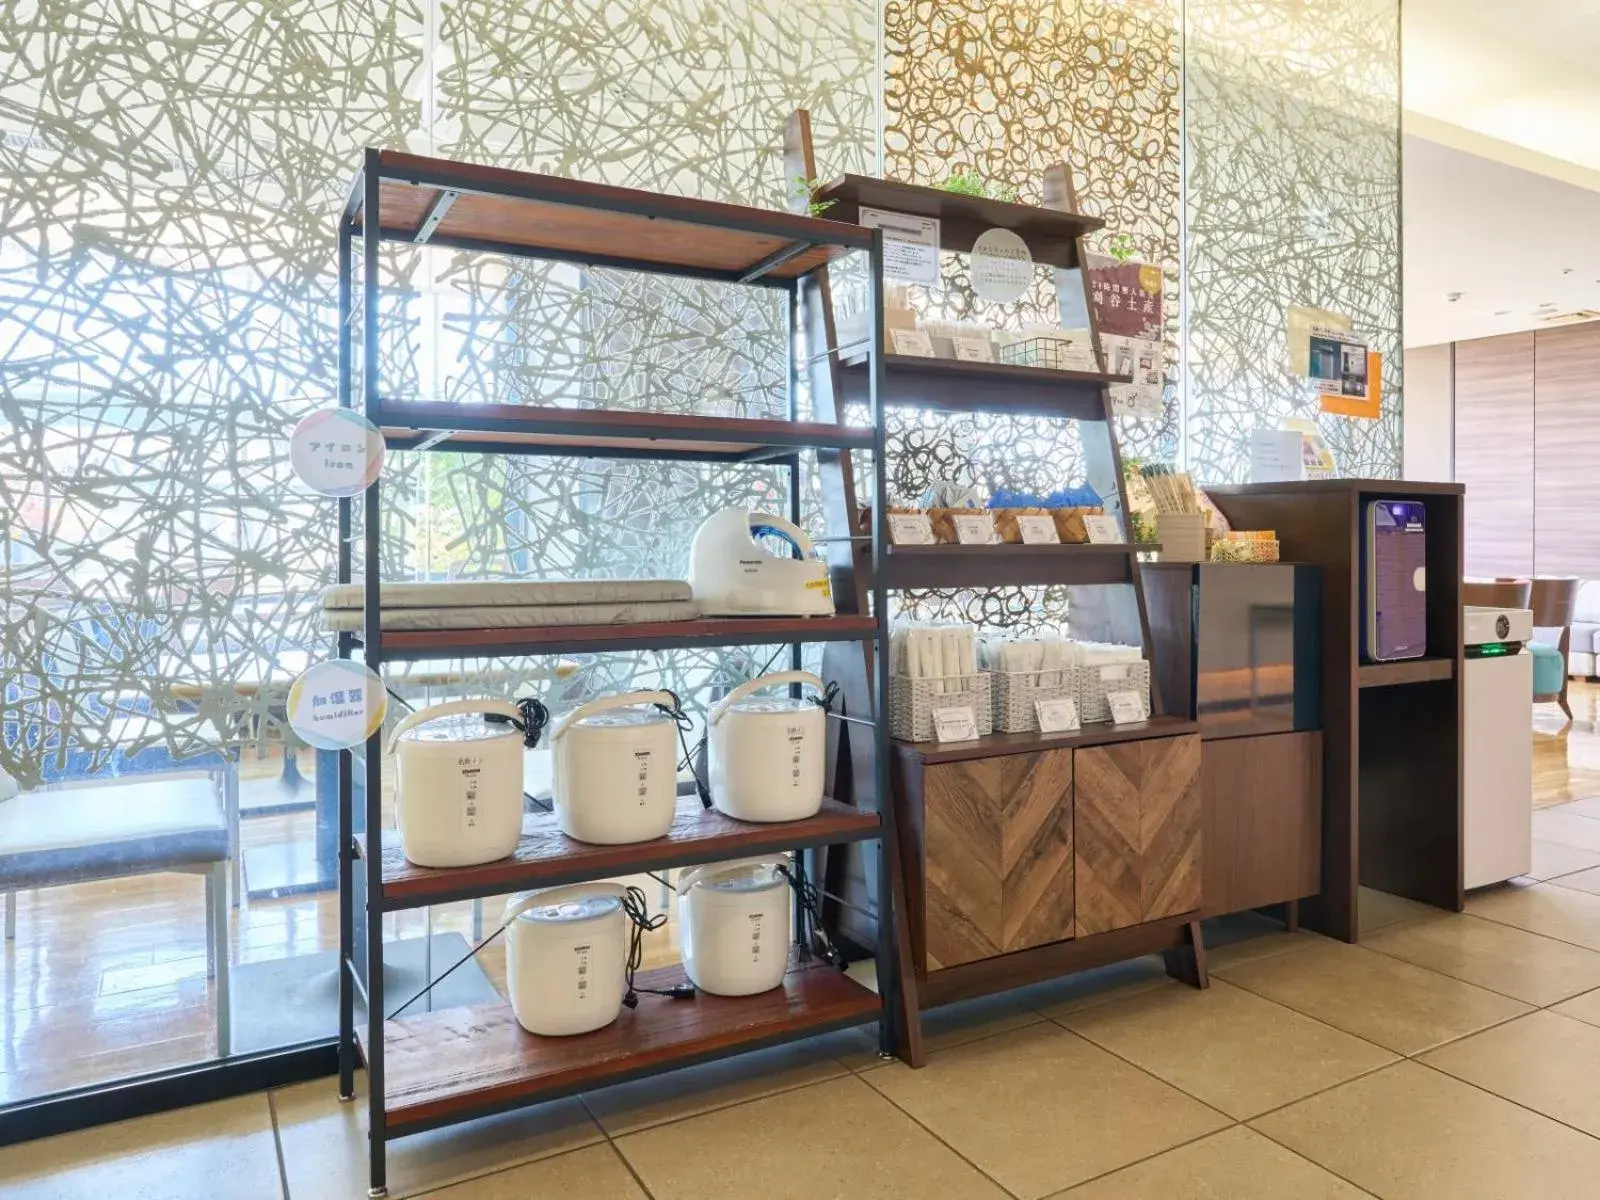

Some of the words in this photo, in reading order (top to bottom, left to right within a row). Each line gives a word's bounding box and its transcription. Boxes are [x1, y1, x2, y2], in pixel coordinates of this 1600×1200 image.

[309, 441, 366, 453] アイロン
[324, 458, 354, 469] Iron
[312, 688, 363, 707] 加湿器
